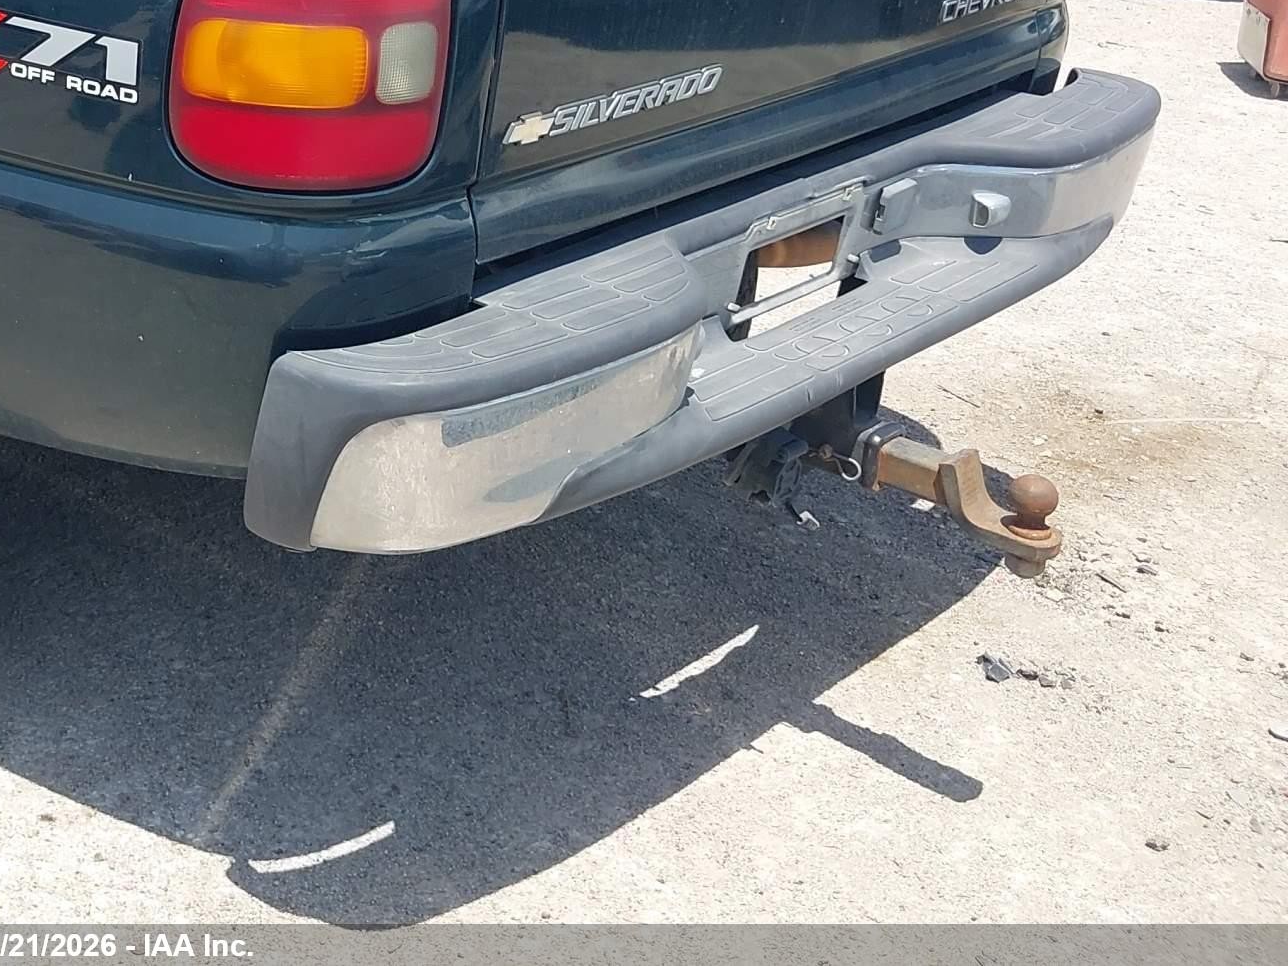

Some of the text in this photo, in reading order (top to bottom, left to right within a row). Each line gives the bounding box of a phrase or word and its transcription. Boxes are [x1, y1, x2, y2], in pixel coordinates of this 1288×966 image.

[10, 62, 139, 105] OFF ROAD
[549, 63, 724, 138] SILVERADO
